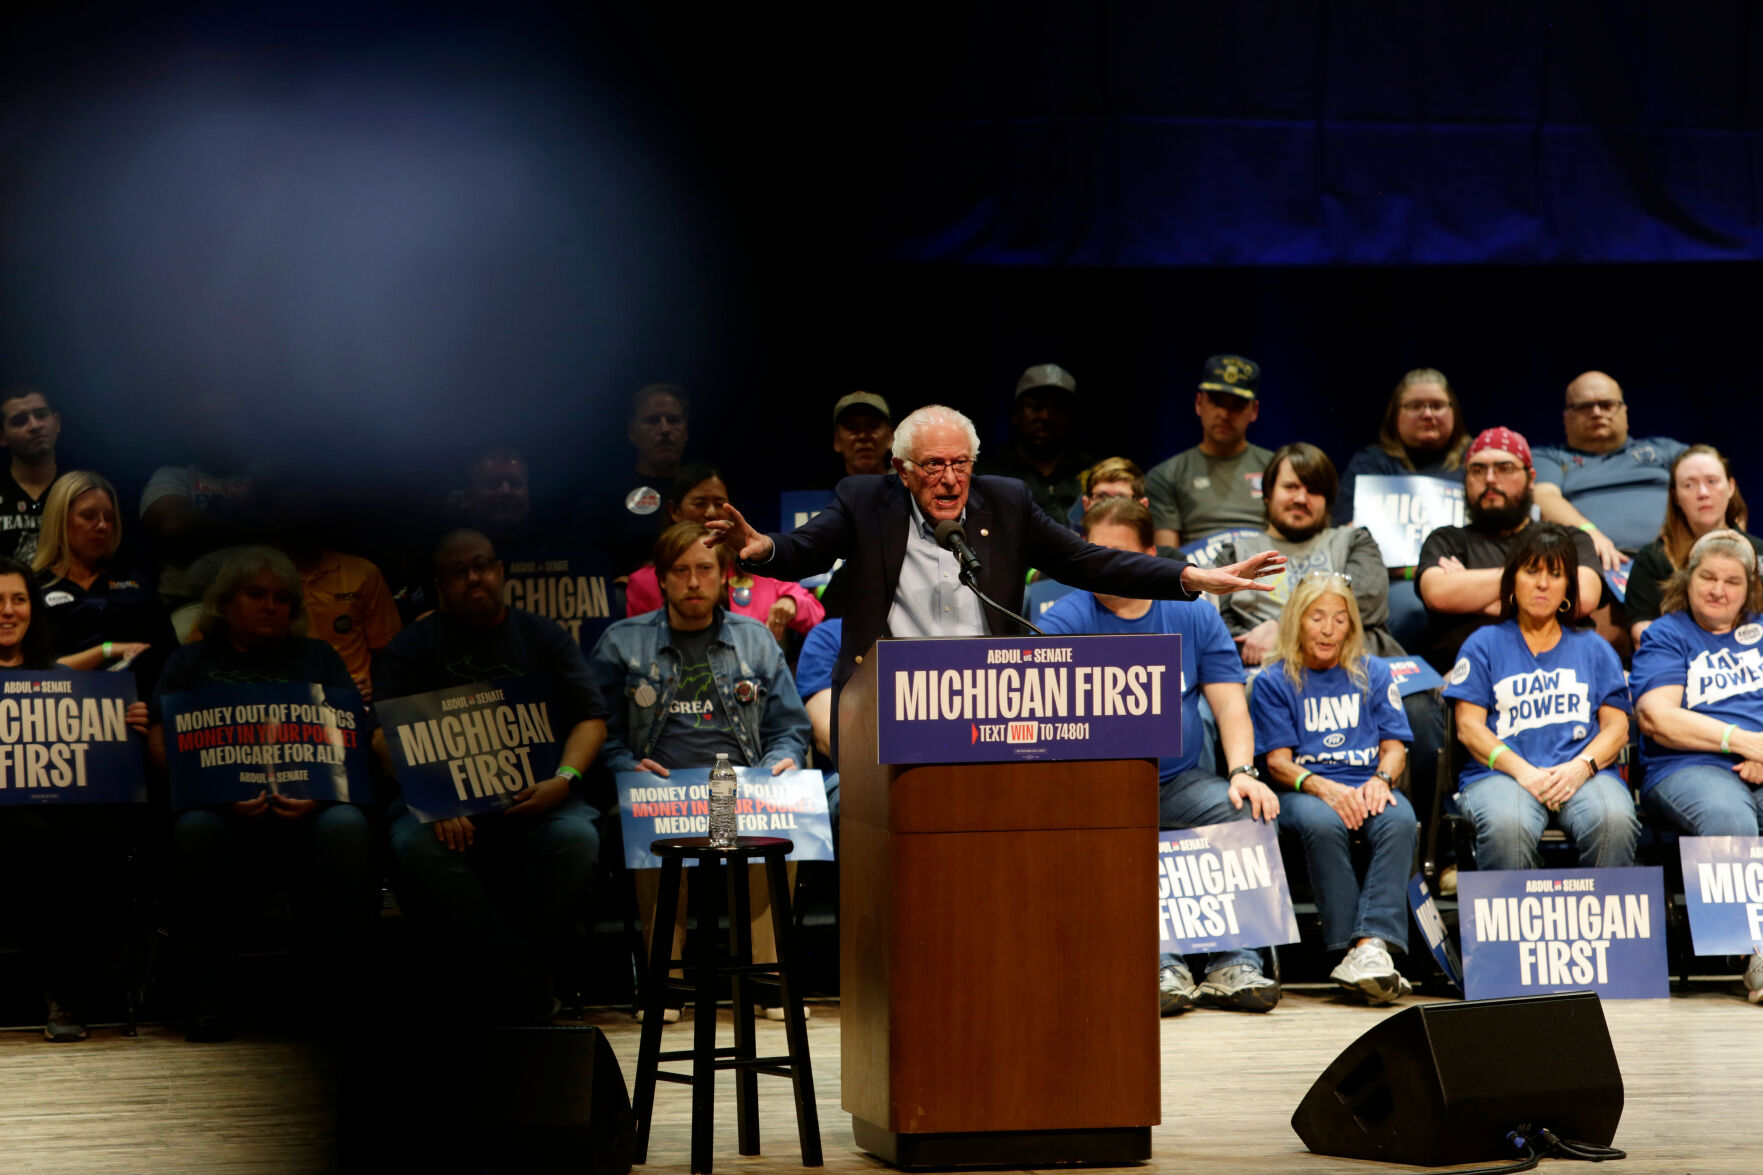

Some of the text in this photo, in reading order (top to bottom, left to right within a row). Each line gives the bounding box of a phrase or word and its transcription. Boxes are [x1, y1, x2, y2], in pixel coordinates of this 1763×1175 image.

[503, 575, 611, 620] CHIGAN
[987, 648, 1073, 664] ABDUL SENATE
[4, 681, 32, 693] ABDUL
[41, 680, 72, 693] SENATE
[895, 665, 1166, 721] MICHIGAN FIRST
[1512, 672, 1560, 697] UAW
[441, 689, 505, 712] ABDUL SENATE
[1304, 693, 1360, 732] UAW
[1509, 693, 1581, 728] POWER
[0, 697, 128, 743] CHIGAN
[175, 706, 232, 733] MONEY
[235, 704, 267, 724] OUT
[268, 703, 289, 723] OF
[979, 722, 1090, 742] TEXT WIN TO 74801
[177, 727, 235, 752] MONEY
[237, 724, 256, 745] IN
[256, 723, 301, 744] YOUR
[396, 701, 557, 767] MICHIGAN
[0, 743, 89, 789] FIRST
[200, 744, 282, 768] MEDICARE
[283, 743, 315, 763] FOR
[448, 746, 537, 801] FIRST
[630, 786, 686, 803] MONEY
[689, 785, 709, 800] OU
[632, 801, 691, 818] MONEY
[693, 800, 709, 815] IN
[655, 813, 799, 834] MEDIC FOR ALL
[1179, 837, 1211, 852] SENATE
[1159, 844, 1272, 899] CHIGAN
[1526, 880, 1554, 893] ABDUL
[1562, 878, 1595, 892] SENATE
[1159, 892, 1241, 941] FIRST
[1474, 894, 1651, 942] MICHIGAN
[1518, 939, 1611, 986] FIRST
